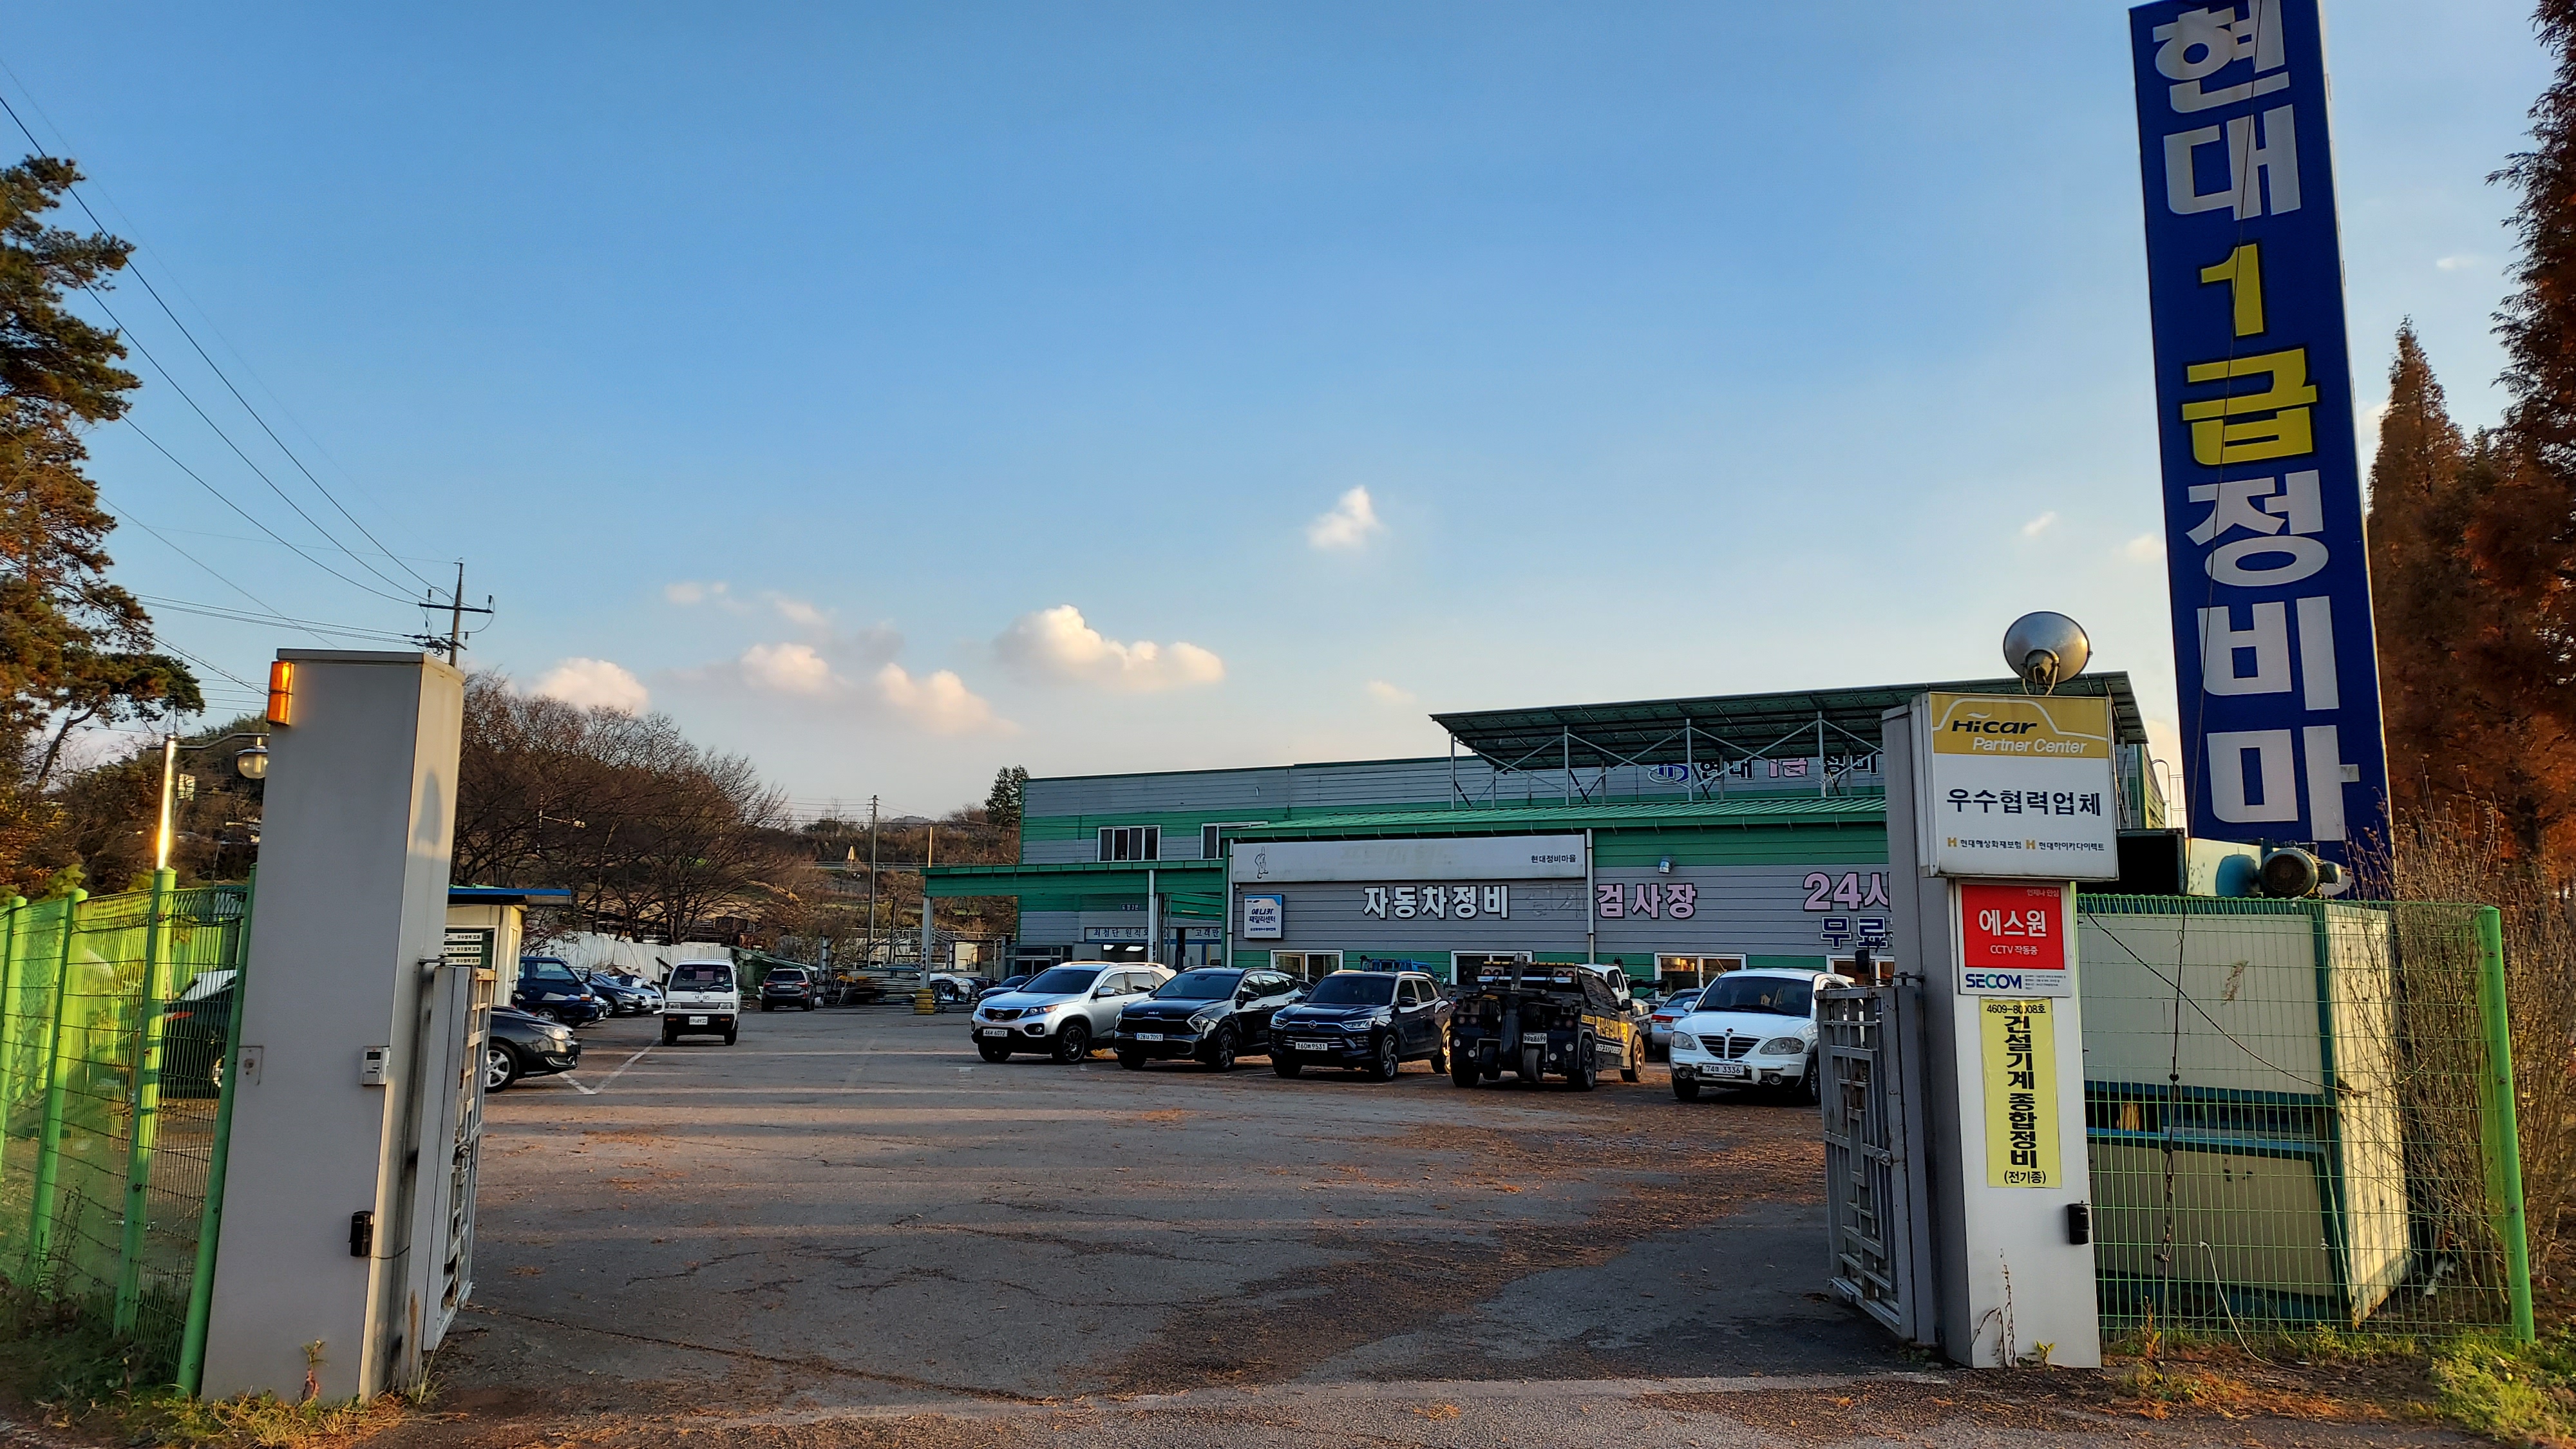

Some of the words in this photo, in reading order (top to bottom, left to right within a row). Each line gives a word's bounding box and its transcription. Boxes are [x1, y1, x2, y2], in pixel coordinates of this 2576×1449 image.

[1952, 719, 2037, 734] Hicar
[1973, 737, 2031, 752] Partner
[2034, 738, 2087, 754] Center
[1946, 788, 2101, 817] 우수협력업체
[1960, 839, 2022, 849] 현대해상화재보험
[2038, 841, 2105, 851] 현대하이카다이렉트
[1531, 854, 1577, 864] 현대정비마을
[1363, 885, 1510, 920] 자동차정비
[1596, 883, 1698, 919] 검사장
[1978, 909, 2047, 937] 에스원
[1195, 928, 1221, 938] 고객만
[1820, 916, 1893, 949] 무료
[1990, 945, 2013, 954] CCTV
[2014, 945, 2038, 955] 작동중
[1965, 973, 2022, 989] SECOM
[2004, 1170, 2046, 1184] (전기종)
